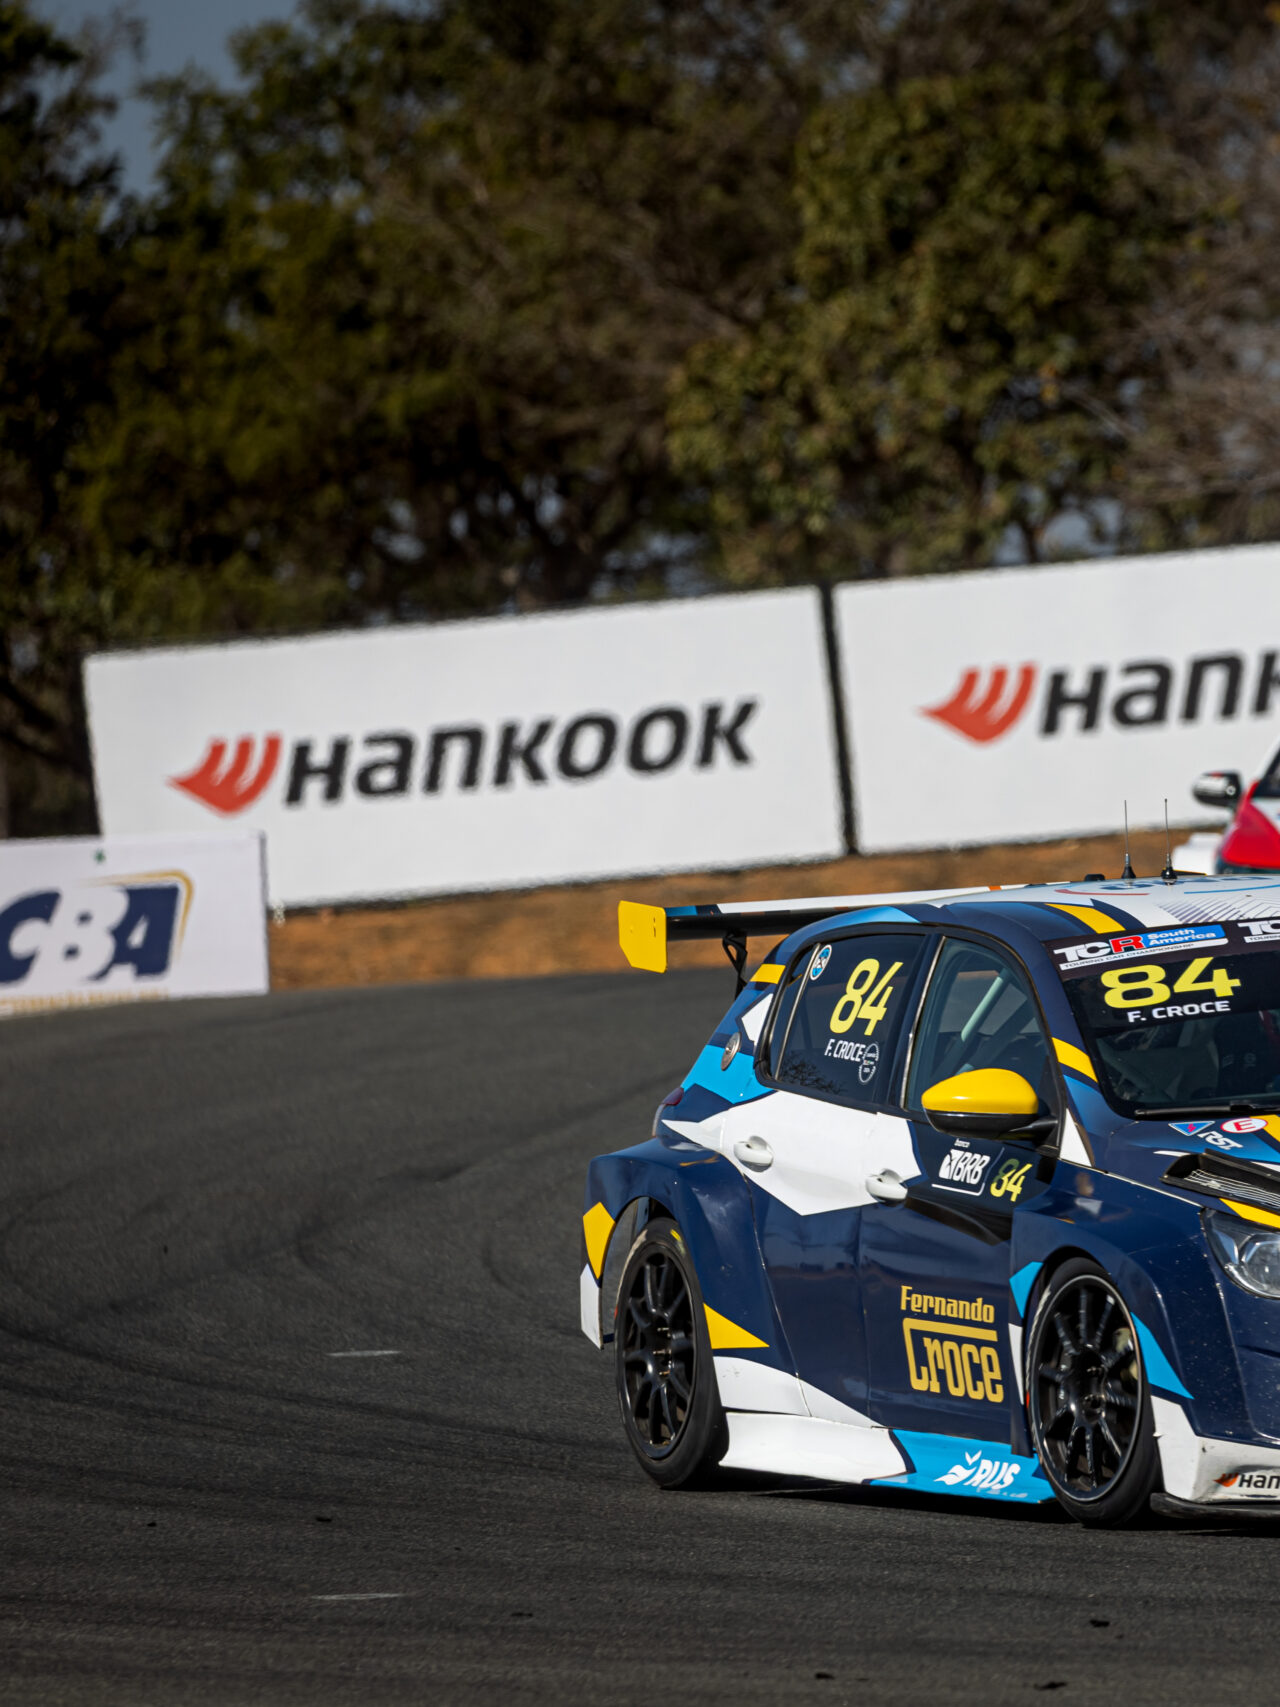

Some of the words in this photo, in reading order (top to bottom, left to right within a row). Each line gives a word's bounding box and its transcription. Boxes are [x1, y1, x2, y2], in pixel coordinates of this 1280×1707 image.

[0, 884, 180, 986] CBA
[1054, 935, 1145, 963] TCR
[1147, 928, 1195, 940] South
[1149, 932, 1217, 947] America
[1106, 952, 1125, 961] CAR
[829, 958, 904, 1036] 84
[1101, 957, 1241, 1009] 84
[1127, 1010, 1147, 1023] F.
[1152, 1000, 1231, 1019] CROCE
[824, 1038, 836, 1057] F.
[833, 1040, 866, 1062] CROCE
[953, 1151, 991, 1185] BRB
[990, 1158, 1033, 1203] 84
[900, 1285, 995, 1324] Fernando
[903, 1317, 1004, 1403] Croce
